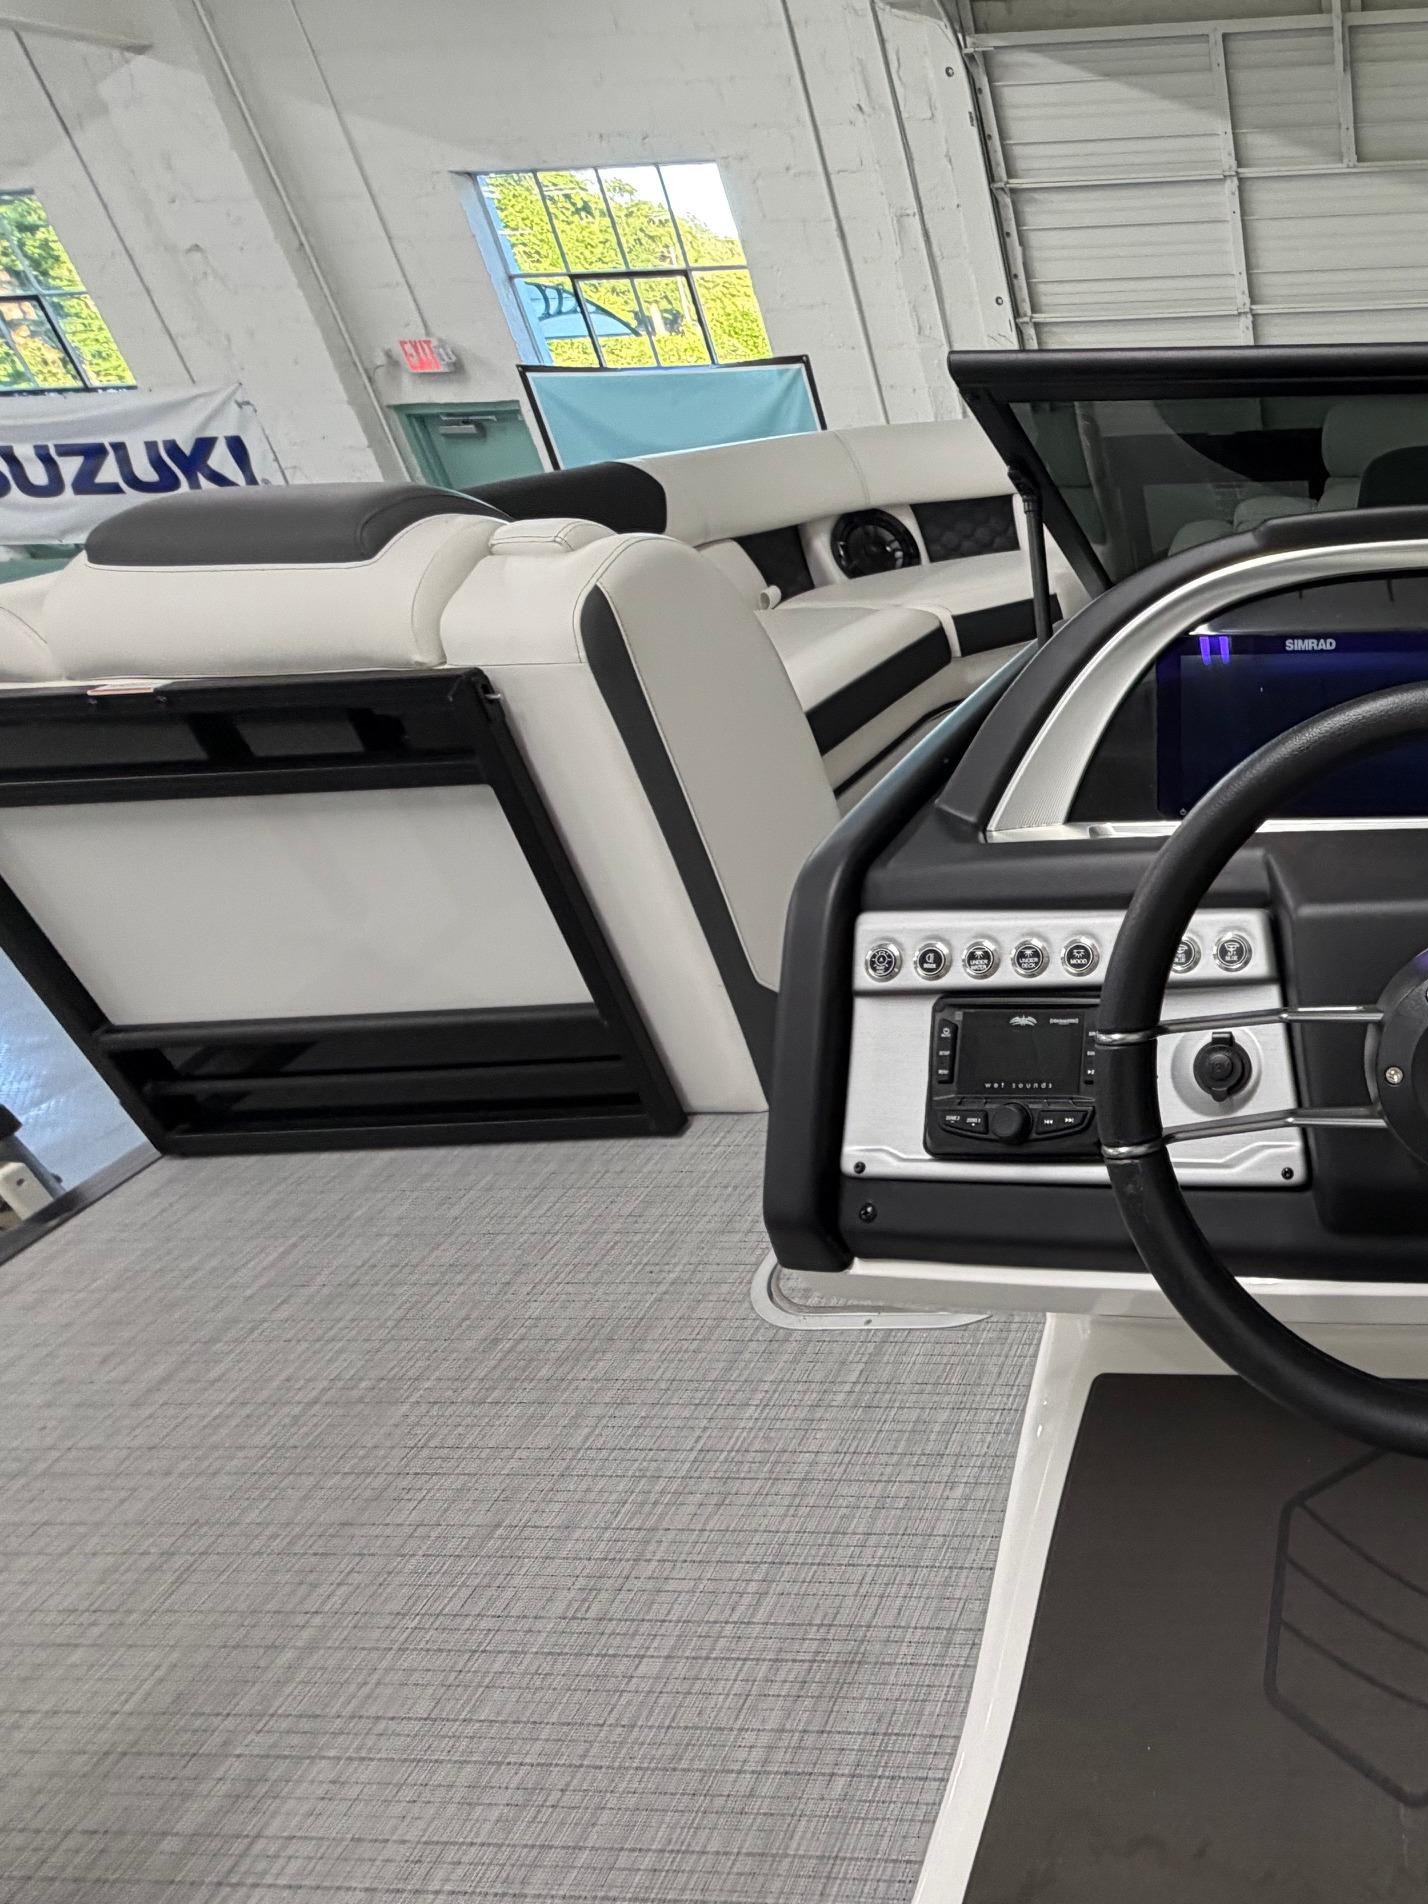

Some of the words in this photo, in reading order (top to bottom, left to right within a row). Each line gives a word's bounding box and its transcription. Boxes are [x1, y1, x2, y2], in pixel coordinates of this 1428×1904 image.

[399, 339, 441, 370] EXIT
[0, 435, 260, 498] UZUKI
[1285, 638, 1337, 651] SIMRAD
[1011, 1081, 1053, 1089] sounds
